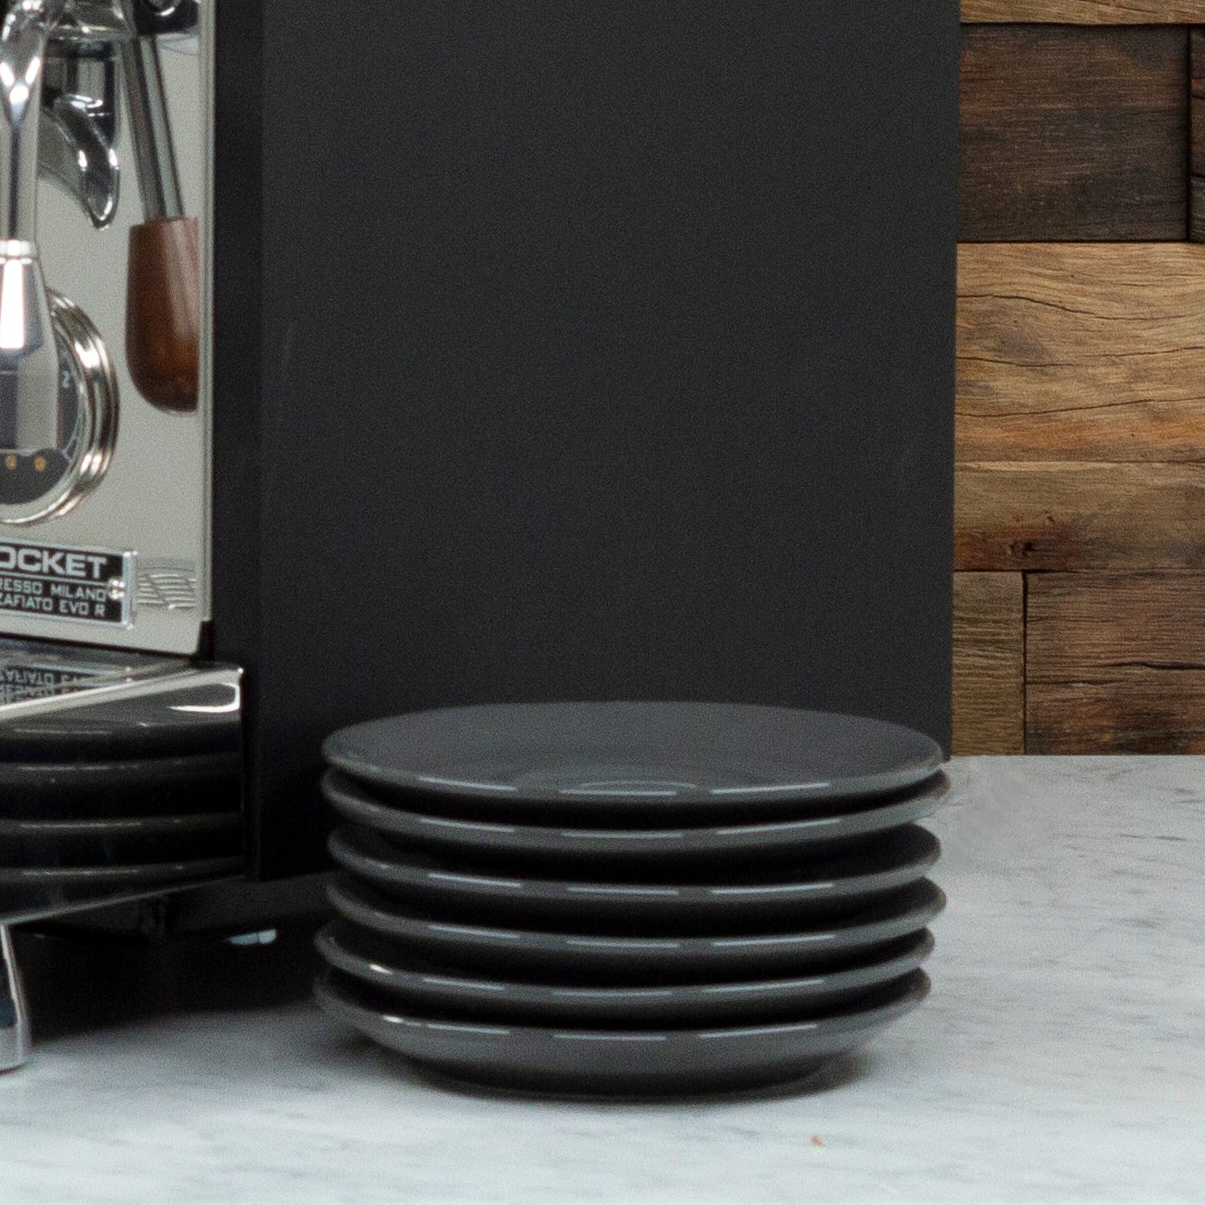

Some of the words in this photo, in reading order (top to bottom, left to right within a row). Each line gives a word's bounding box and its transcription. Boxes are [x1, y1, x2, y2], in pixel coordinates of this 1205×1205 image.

[50, 582, 108, 603] MILANO
[59, 601, 90, 617] EVO
[94, 602, 106, 617] R
